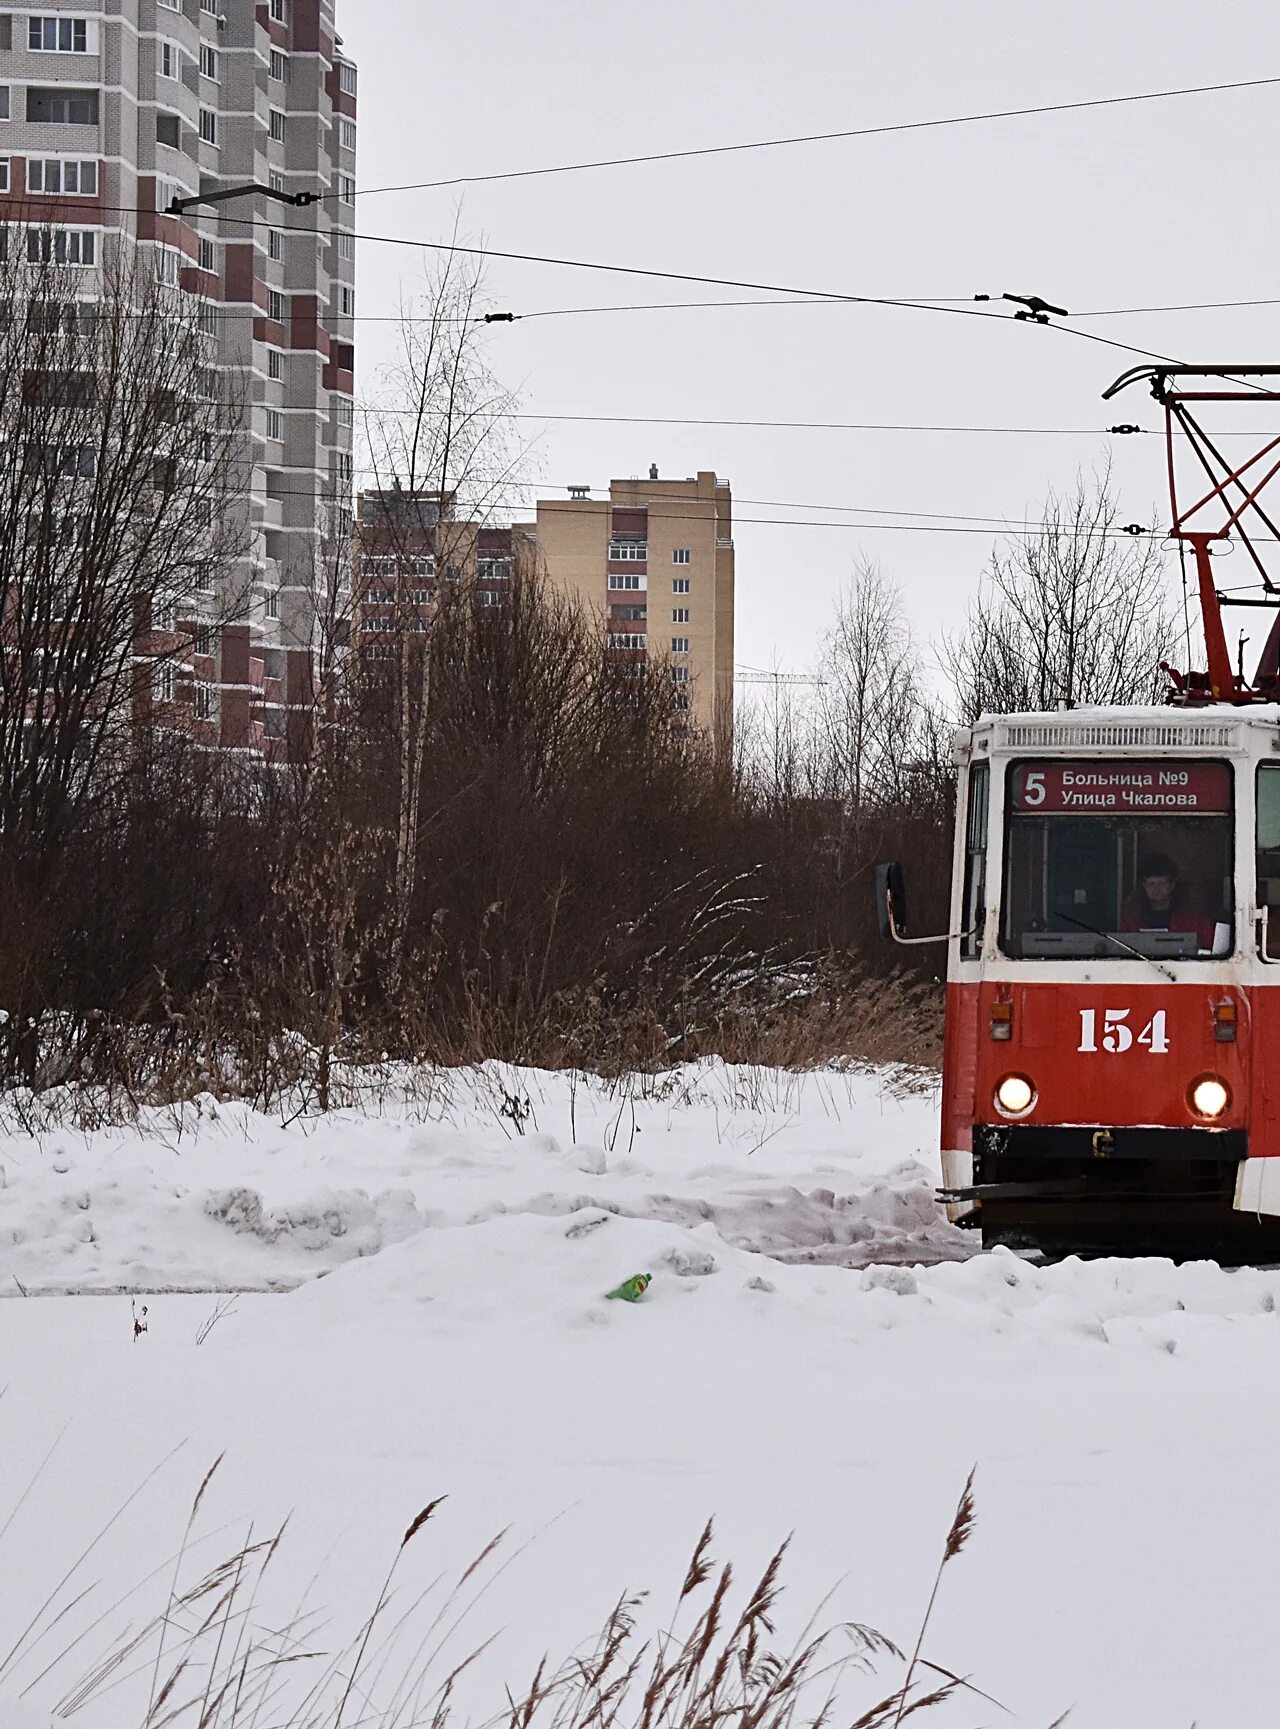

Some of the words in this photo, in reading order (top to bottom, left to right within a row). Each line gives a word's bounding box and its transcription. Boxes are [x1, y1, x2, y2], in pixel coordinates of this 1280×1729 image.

[1024, 772, 1046, 805] 5
[1062, 770, 1152, 787] Больница
[1158, 771, 1189, 785] №9
[1061, 790, 1116, 807] Улица
[1122, 790, 1197, 805] Чкалова
[1077, 1008, 1170, 1053] 154
